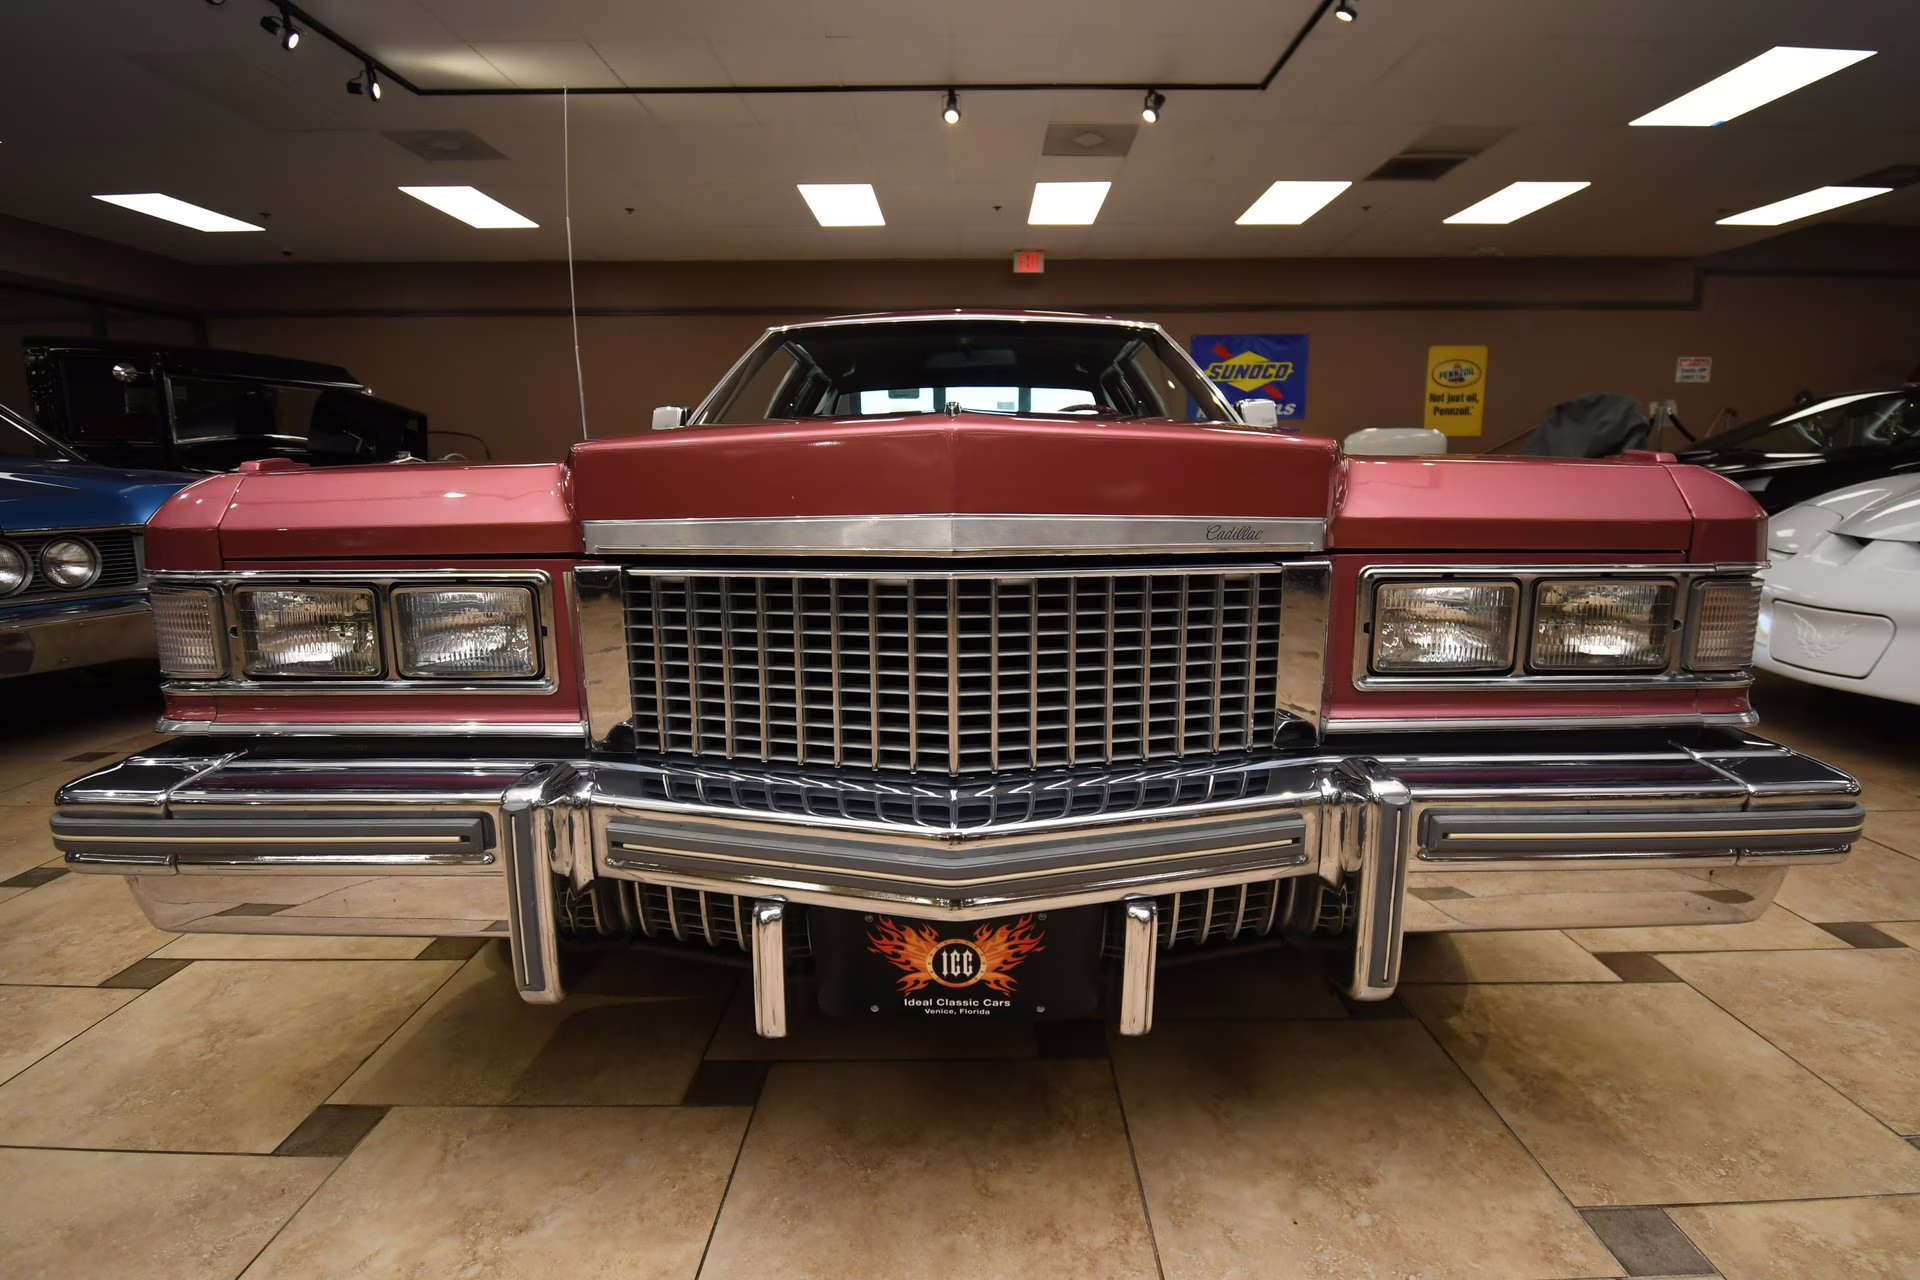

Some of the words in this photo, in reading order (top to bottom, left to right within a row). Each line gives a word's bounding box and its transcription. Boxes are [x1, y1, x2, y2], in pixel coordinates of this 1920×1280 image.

[1209, 363, 1289, 380] SUNOCO
[1429, 393, 1445, 403] Not
[1447, 393, 1465, 405] just
[1467, 392, 1480, 405] oil,
[1206, 524, 1264, 541] Cadillac
[942, 949, 974, 978] ICC
[904, 998, 933, 1007] Ideal
[936, 998, 980, 1007] Classic
[983, 998, 1011, 1007] Cars
